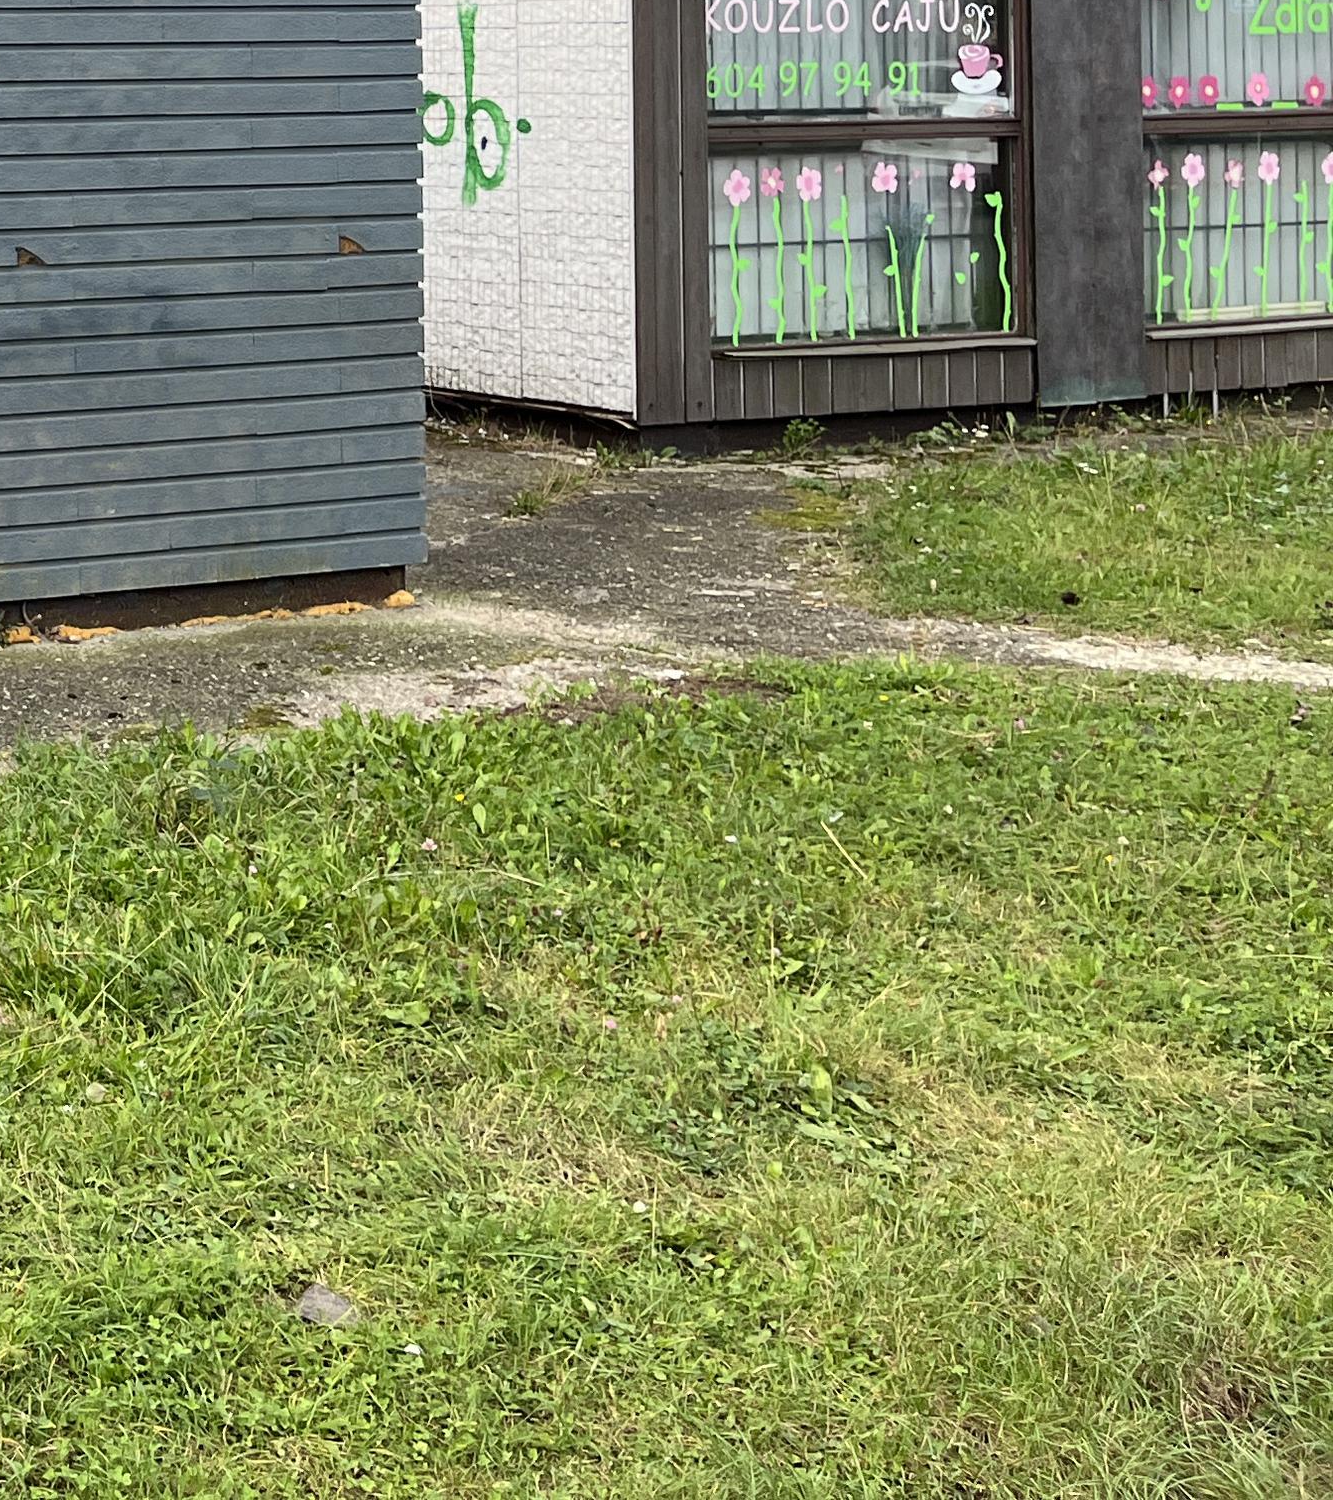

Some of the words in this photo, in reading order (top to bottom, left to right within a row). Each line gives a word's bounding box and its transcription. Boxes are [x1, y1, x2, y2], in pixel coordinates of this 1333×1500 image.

[706, 62, 766, 99] 604
[779, 60, 820, 97] 97
[834, 60, 872, 97] 94
[888, 60, 922, 97] 91
